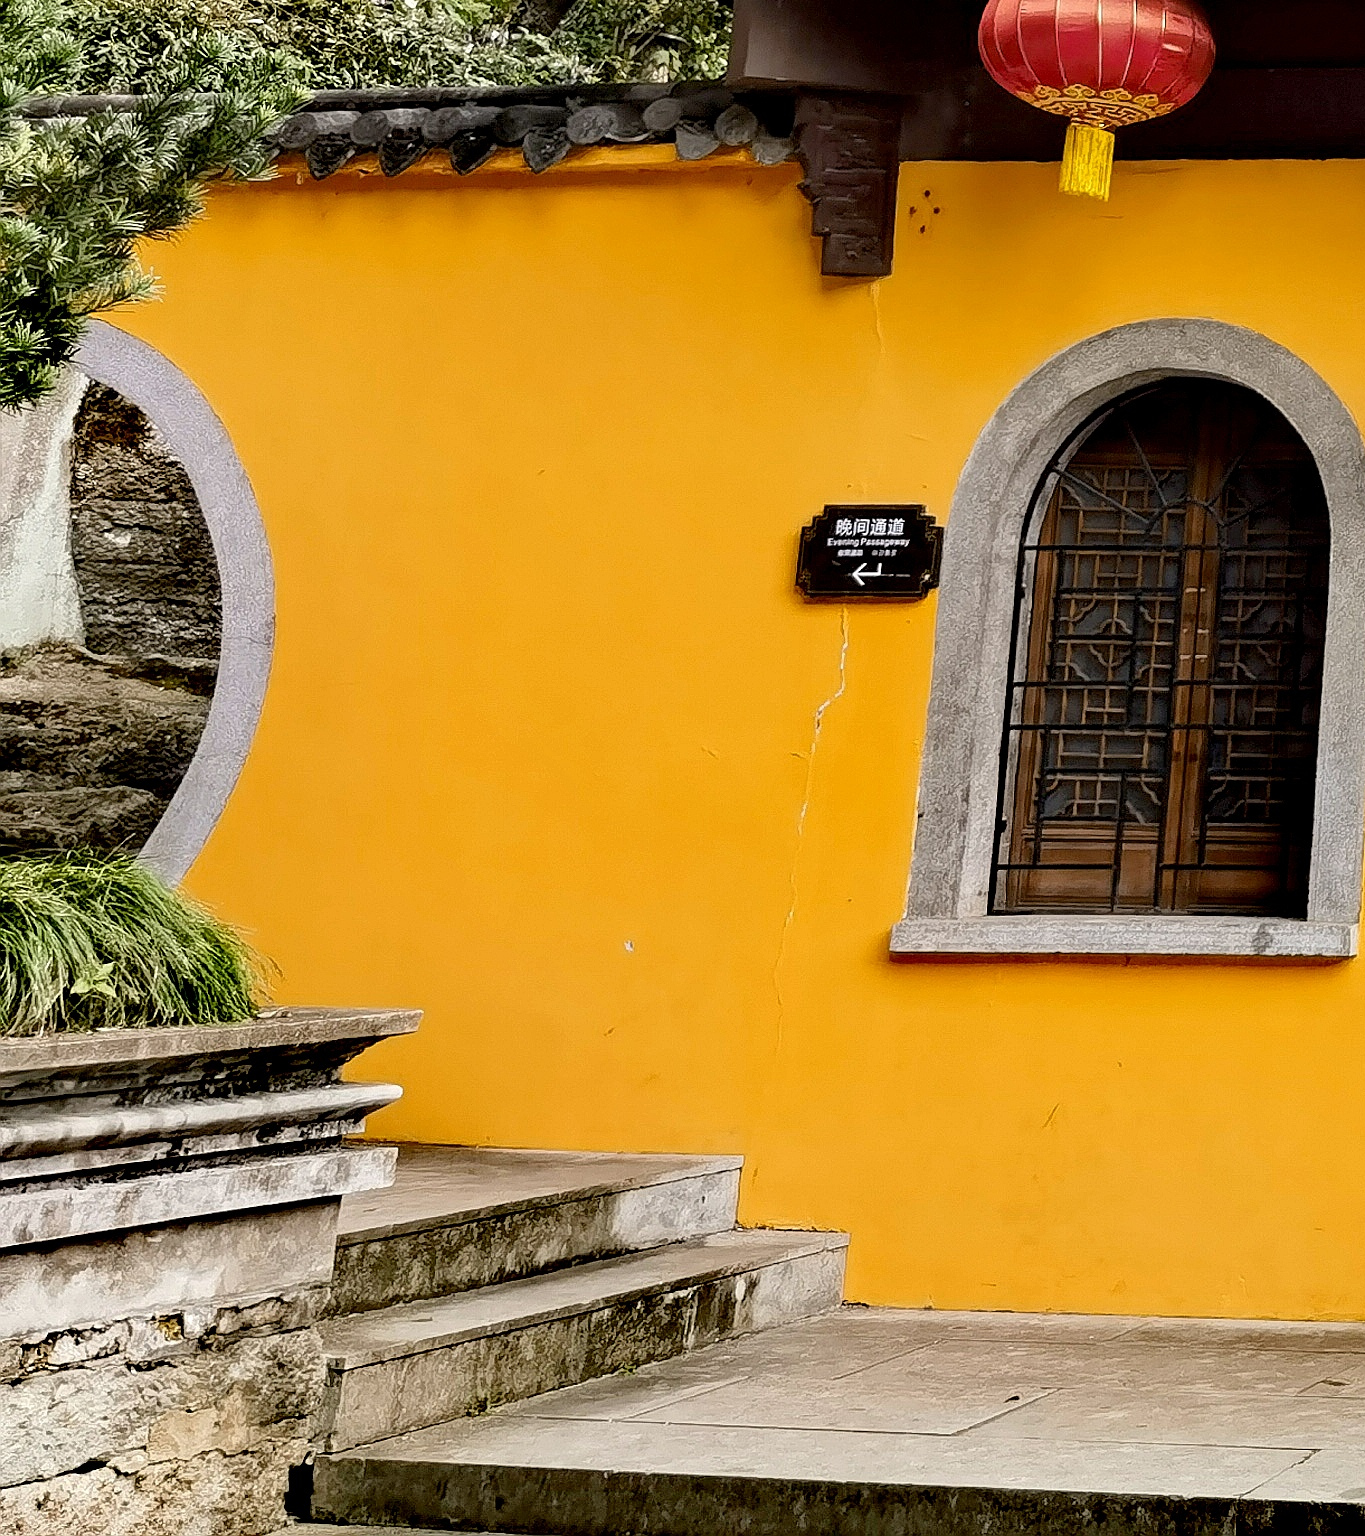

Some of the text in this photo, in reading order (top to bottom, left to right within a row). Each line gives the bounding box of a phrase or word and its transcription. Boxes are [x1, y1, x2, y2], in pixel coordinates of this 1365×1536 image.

[835, 517, 906, 537] 晚间通道
[826, 537, 911, 548] Evening Passageway
